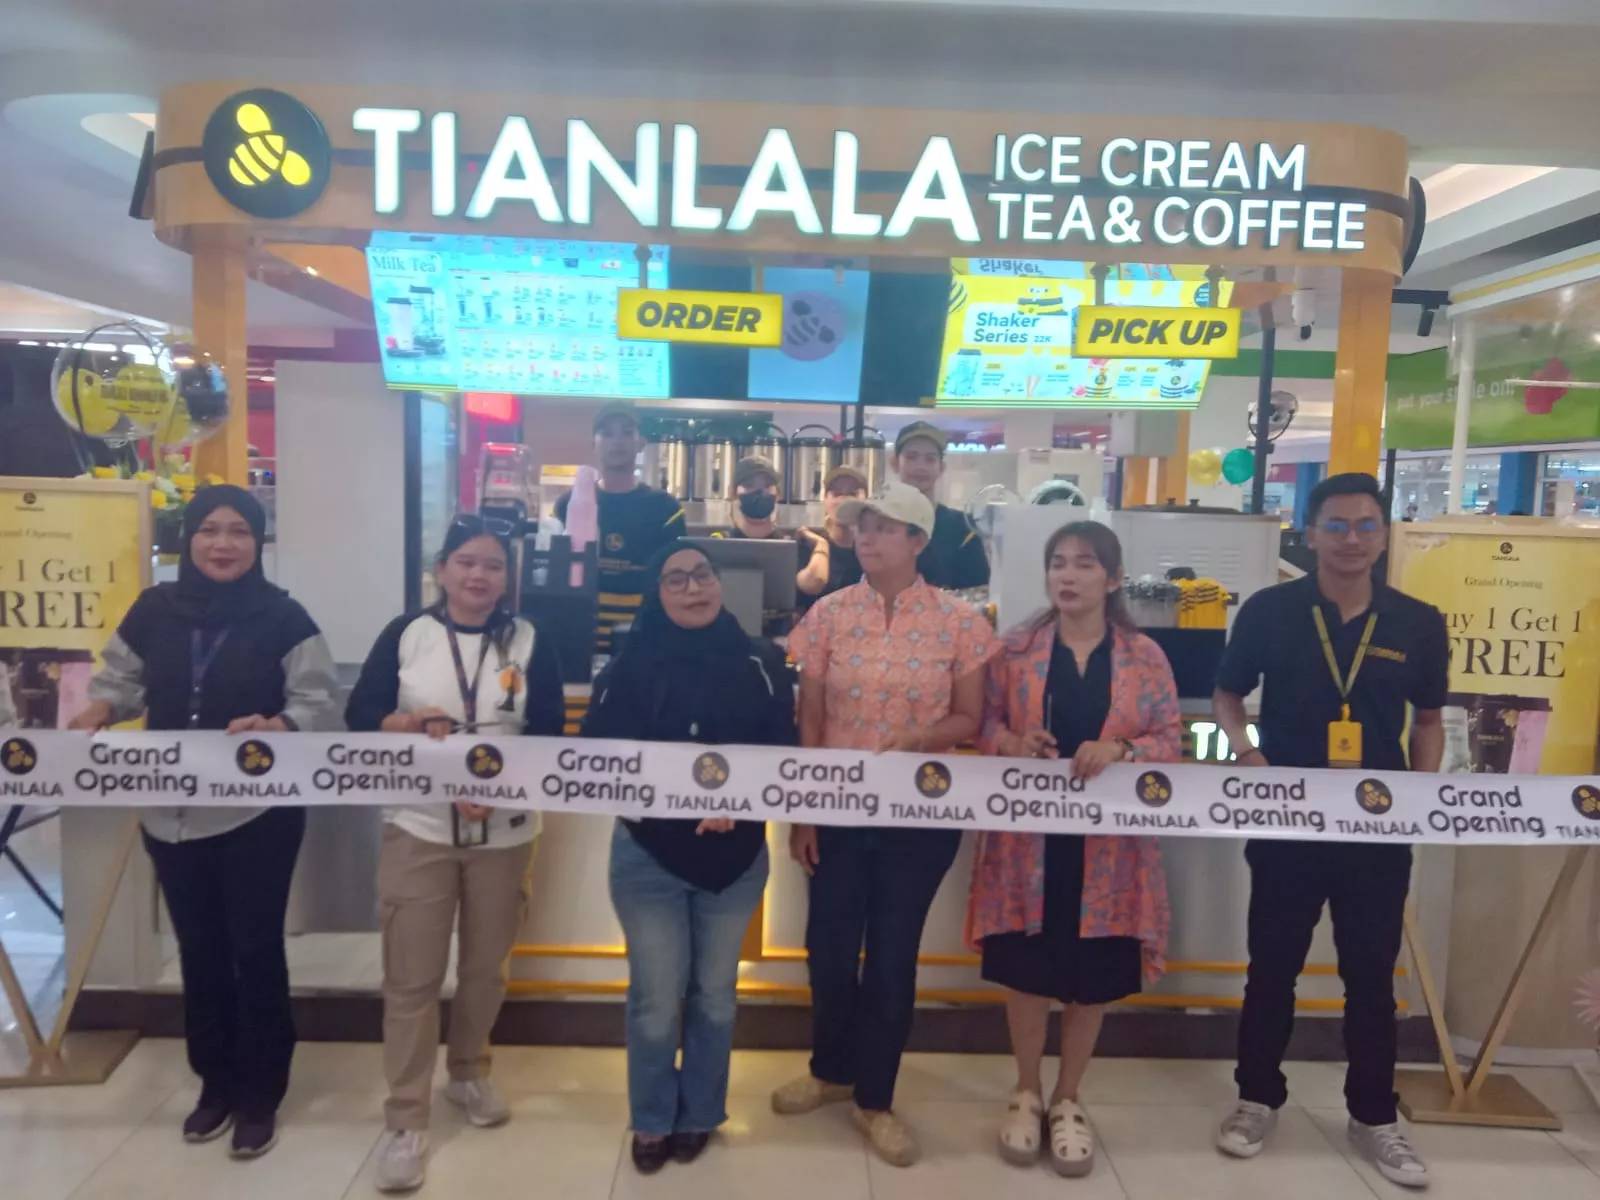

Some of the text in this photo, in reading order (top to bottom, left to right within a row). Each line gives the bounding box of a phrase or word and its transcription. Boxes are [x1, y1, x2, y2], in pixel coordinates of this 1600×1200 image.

[352, 107, 981, 242] TIANLALA
[995, 133, 1306, 191] ICE CREAM
[1154, 196, 1366, 250] COFFEE
[372, 256, 436, 273] Milk Tea
[637, 300, 761, 332] ORDER
[976, 311, 1040, 328] Shaker
[974, 328, 1028, 343] Series
[1088, 318, 1228, 345] PICK UP
[41, 558, 92, 583] Get
[1444, 611, 1474, 633] uy
[1511, 606, 1559, 633] Get
[89, 741, 181, 765] Grand
[327, 743, 414, 766] Grand
[557, 748, 642, 774] Grand
[75, 768, 198, 797] Opening
[312, 768, 432, 795] Opening
[779, 757, 864, 783] Grand
[209, 783, 300, 797] TIANLALA
[442, 783, 528, 800] TIANLALA
[542, 774, 655, 808] Opening
[762, 784, 880, 817] Opening
[1222, 776, 1306, 801] Grand
[1438, 784, 1522, 808] Grand
[665, 793, 752, 812] TIANLALA
[890, 803, 976, 821] TIANLALA
[986, 793, 1102, 824] Opening
[1113, 812, 1199, 828] TIANLALA
[1208, 802, 1325, 832] Opening
[1336, 820, 1424, 837] TIANLALA
[1428, 810, 1546, 838] Opening
